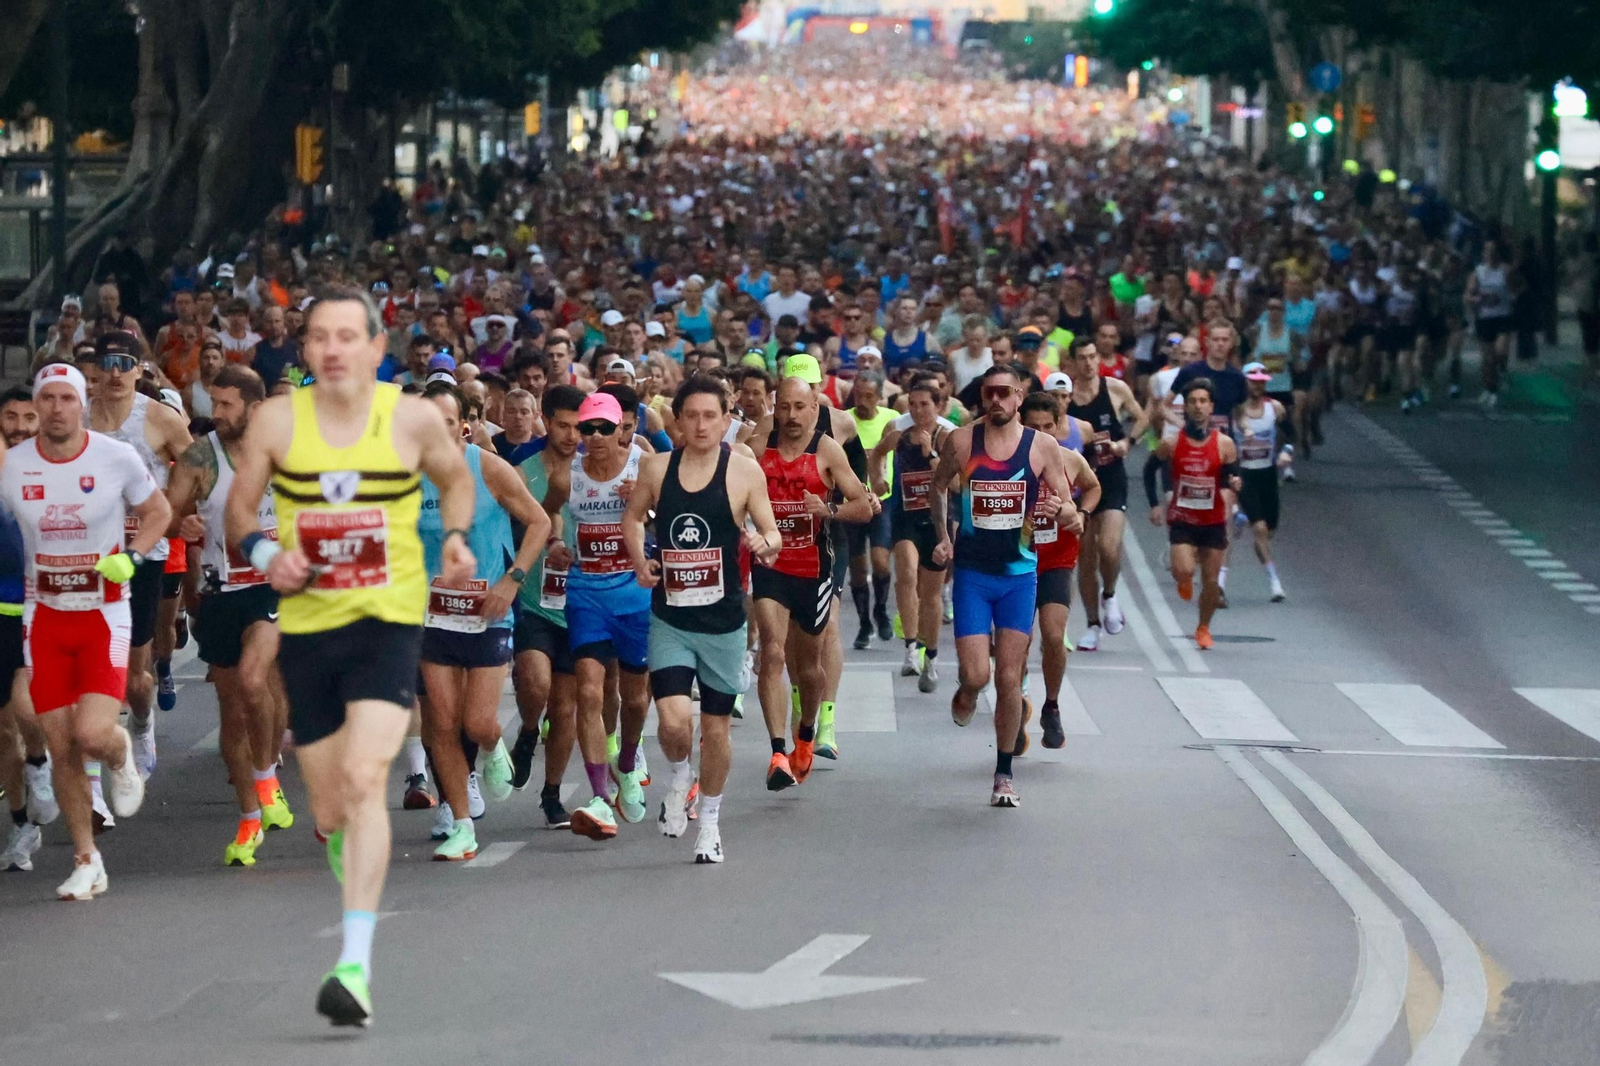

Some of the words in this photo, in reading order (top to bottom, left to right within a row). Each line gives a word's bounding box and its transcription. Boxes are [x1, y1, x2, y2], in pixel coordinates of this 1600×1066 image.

[985, 483, 1021, 491] GENERALI
[982, 498, 1014, 508] 13598
[590, 541, 619, 552] 6168
[50, 556, 96, 566] GENERALI
[675, 552, 717, 561] GENERALI
[47, 573, 88, 586] 15626
[673, 569, 709, 582] 15057
[440, 596, 474, 609] 13862
